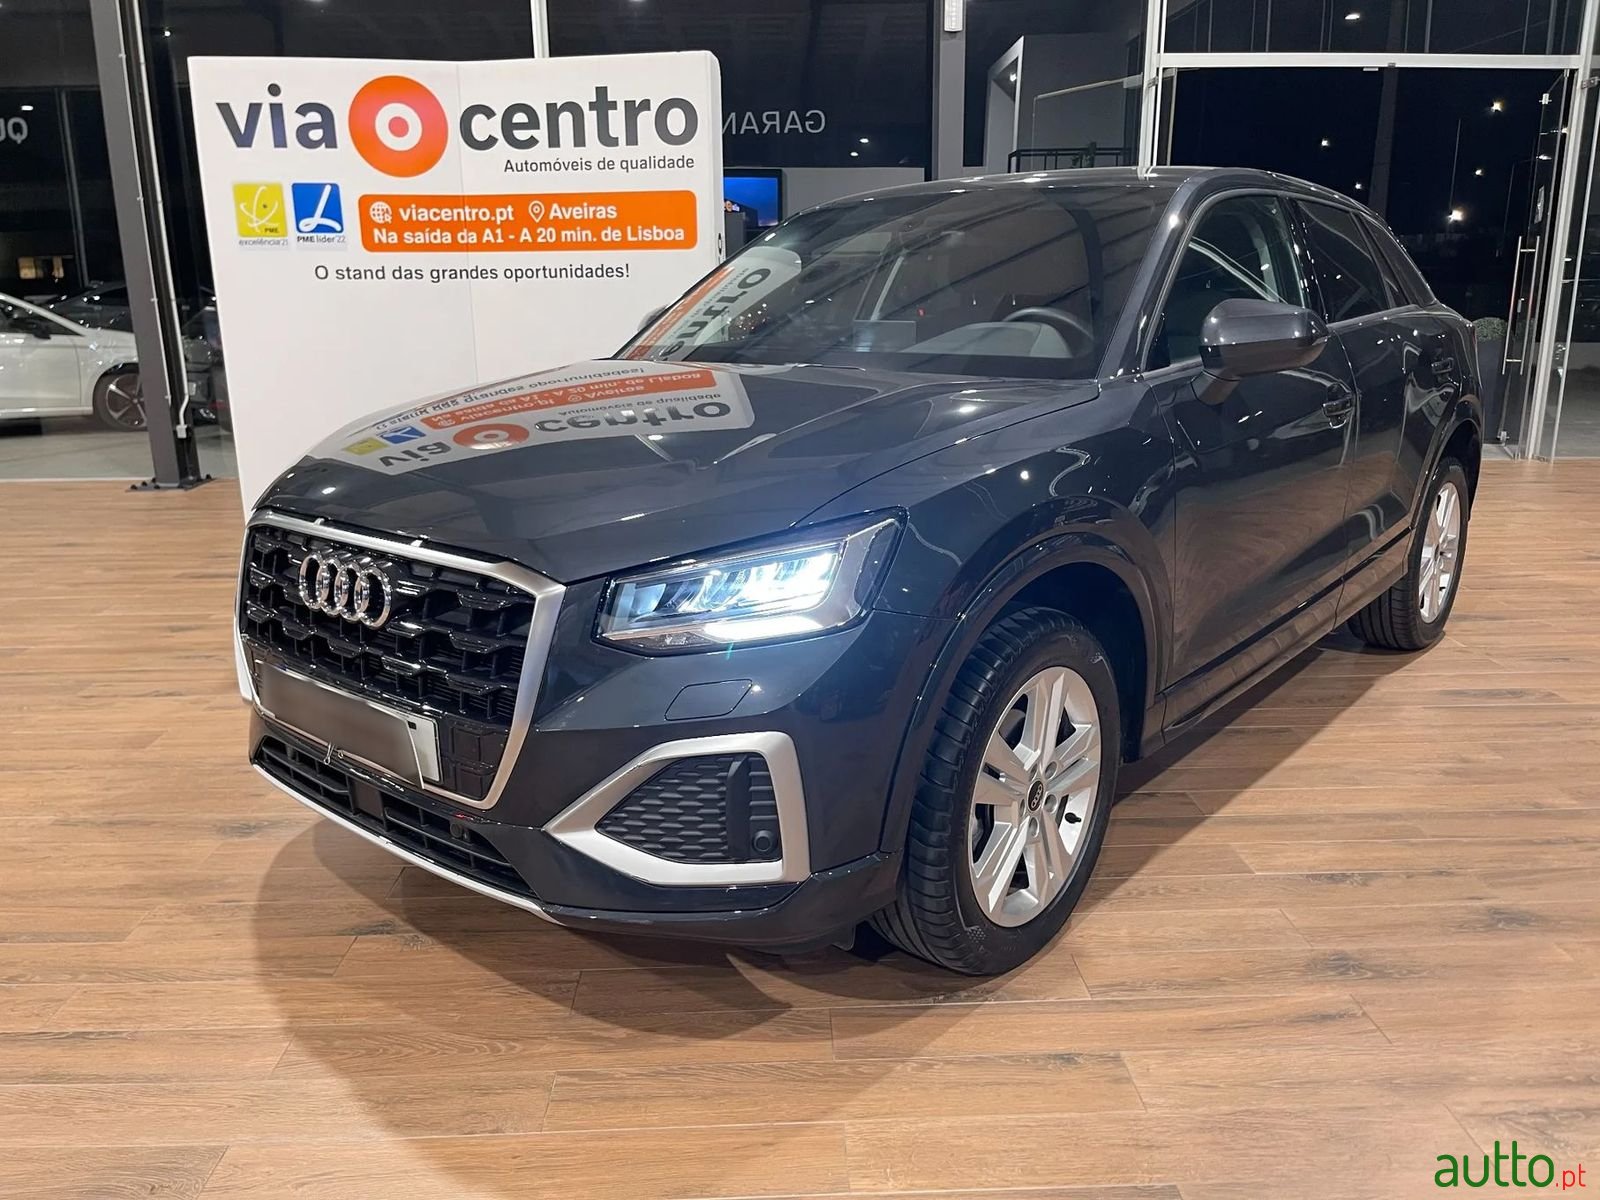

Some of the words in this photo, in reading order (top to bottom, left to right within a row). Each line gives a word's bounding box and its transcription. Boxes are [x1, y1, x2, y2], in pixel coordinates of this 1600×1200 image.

[215, 83, 338, 150] via
[459, 85, 699, 151] centro
[504, 157, 593, 173] Automóveis
[597, 156, 615, 171] de
[620, 154, 695, 173] qualidade
[398, 204, 514, 225] viacentro.pt
[549, 202, 618, 220] Aveiras
[297, 235, 315, 244] PME
[373, 228, 398, 244] Na
[403, 228, 452, 244] saída
[457, 229, 477, 244] da
[482, 228, 504, 244] A1
[519, 227, 532, 243] A
[536, 227, 556, 243] 20
[561, 226, 597, 242] min.
[601, 226, 622, 242] de
[627, 225, 685, 241] Lisboa
[314, 265, 329, 281] O
[335, 265, 386, 281] stand
[391, 265, 424, 281] das
[429, 265, 499, 284] grandes
[503, 263, 630, 283] oportunidades!
